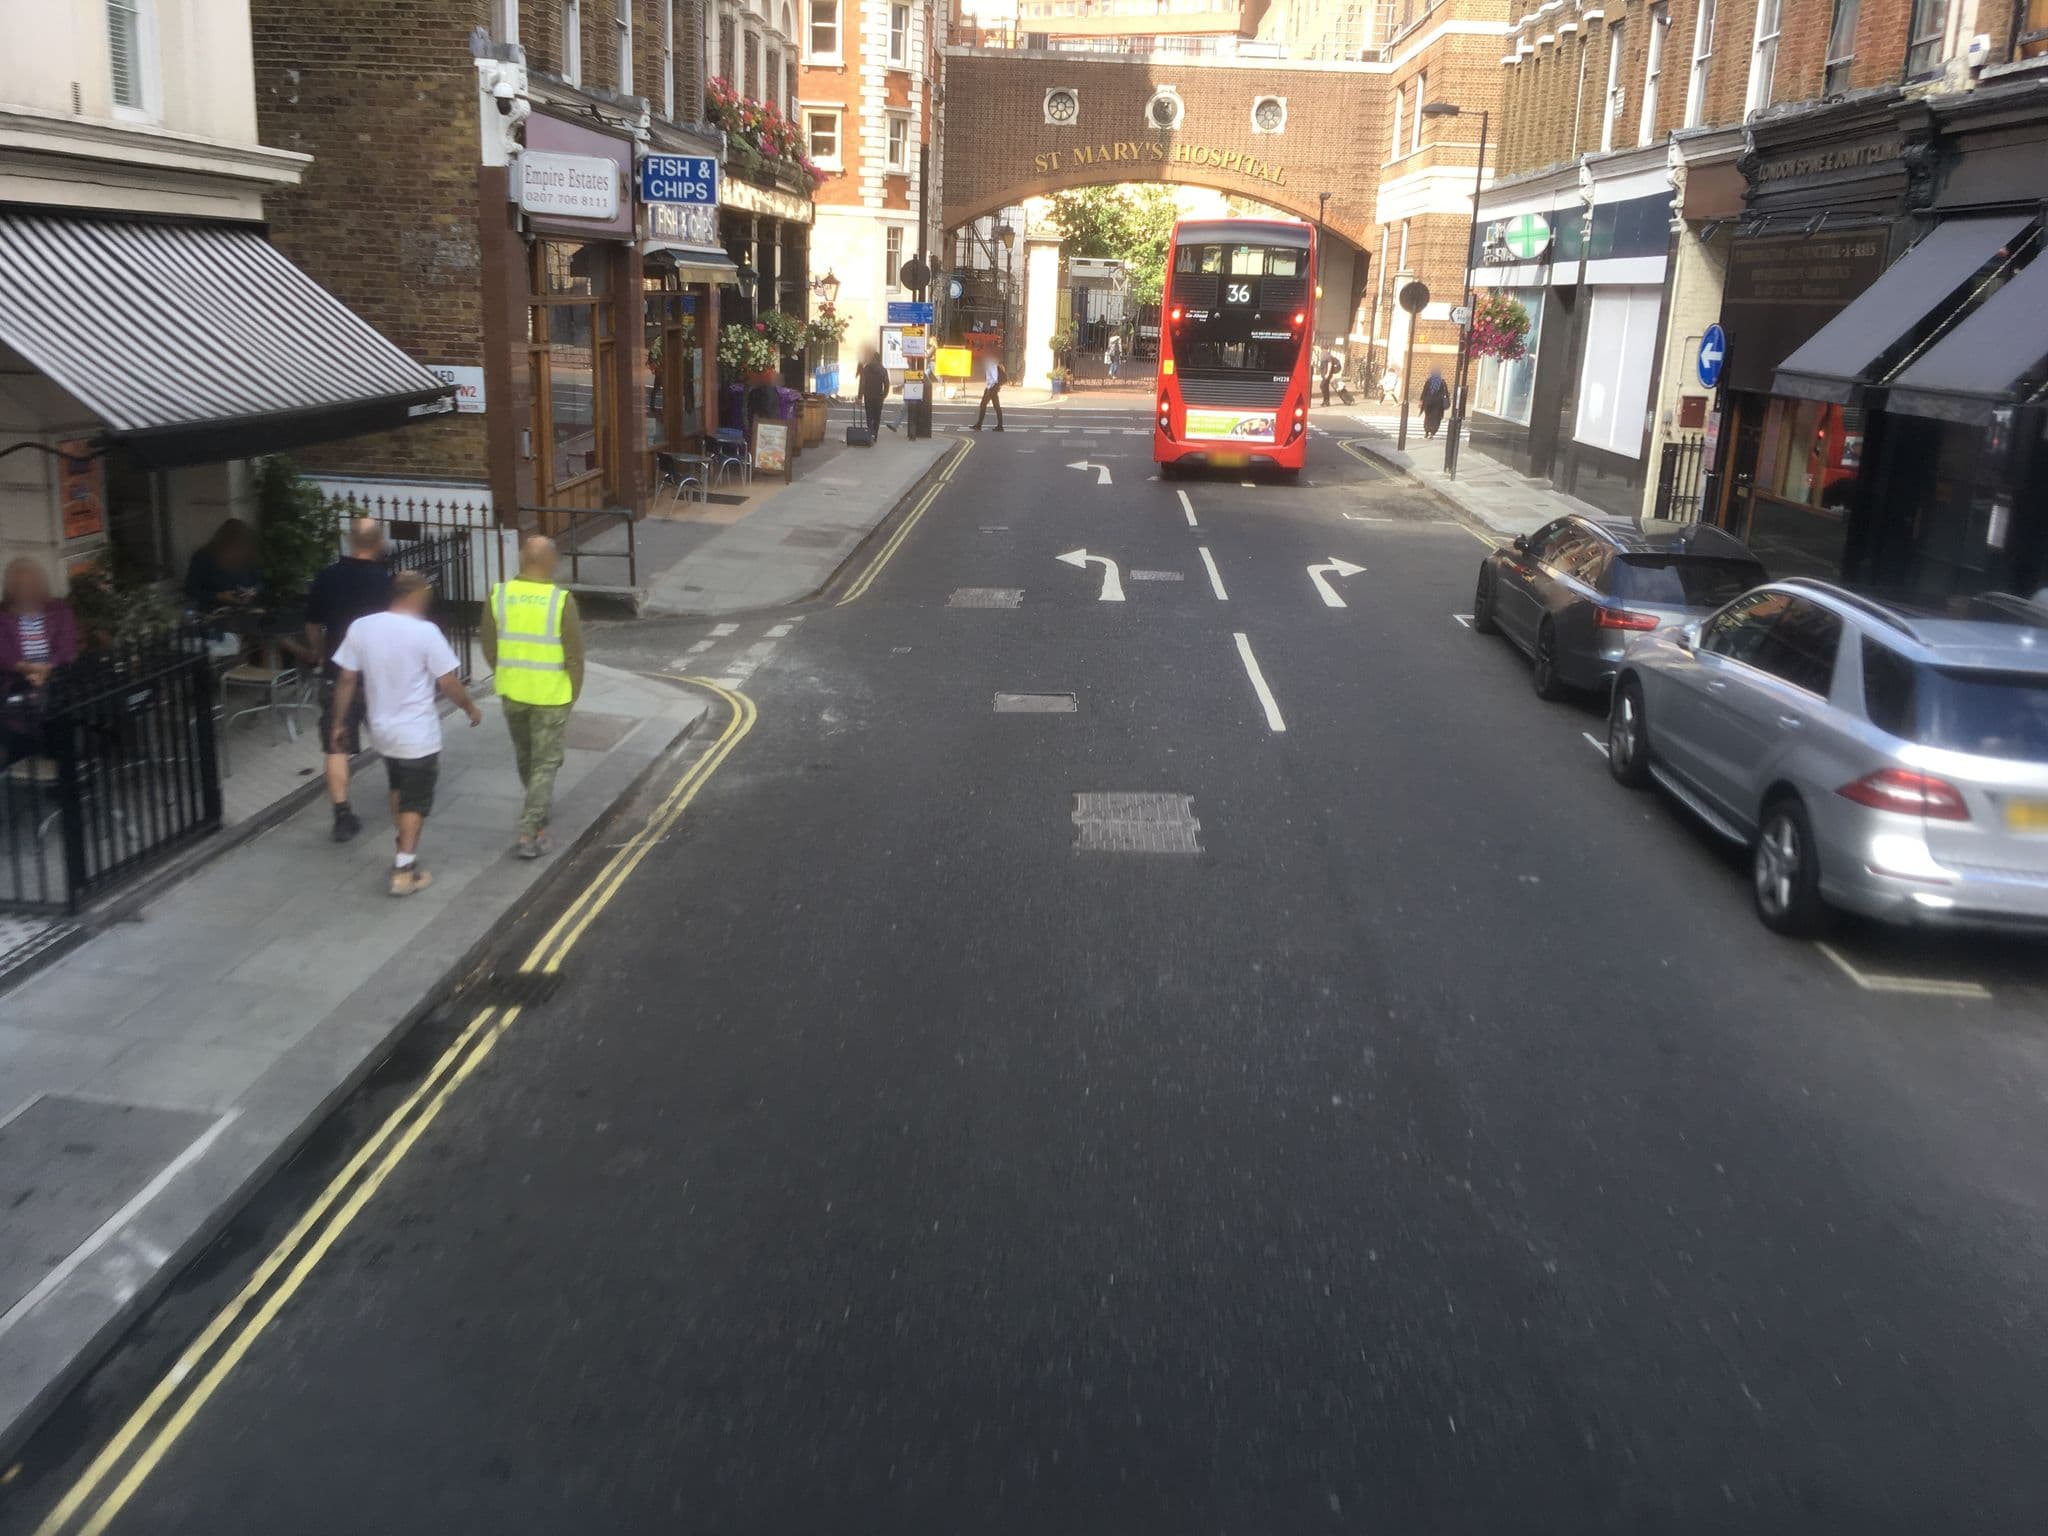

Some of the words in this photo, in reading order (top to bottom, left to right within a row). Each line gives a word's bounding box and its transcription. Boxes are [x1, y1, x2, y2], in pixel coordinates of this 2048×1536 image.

[647, 158, 690, 178] FISH
[698, 161, 711, 179] &
[1034, 151, 1061, 174] ST
[1074, 142, 1164, 166] MARY'S
[1174, 144, 1287, 187] HOSPITAL
[525, 165, 565, 191] Empire
[568, 168, 609, 191] Estates
[526, 192, 554, 203] 0207
[558, 194, 579, 205] 706
[581, 196, 608, 208] 8111
[650, 180, 708, 200] CHIPS
[658, 207, 679, 236] FISH
[691, 213, 714, 242] CHIPS
[1227, 284, 1250, 302] 36
